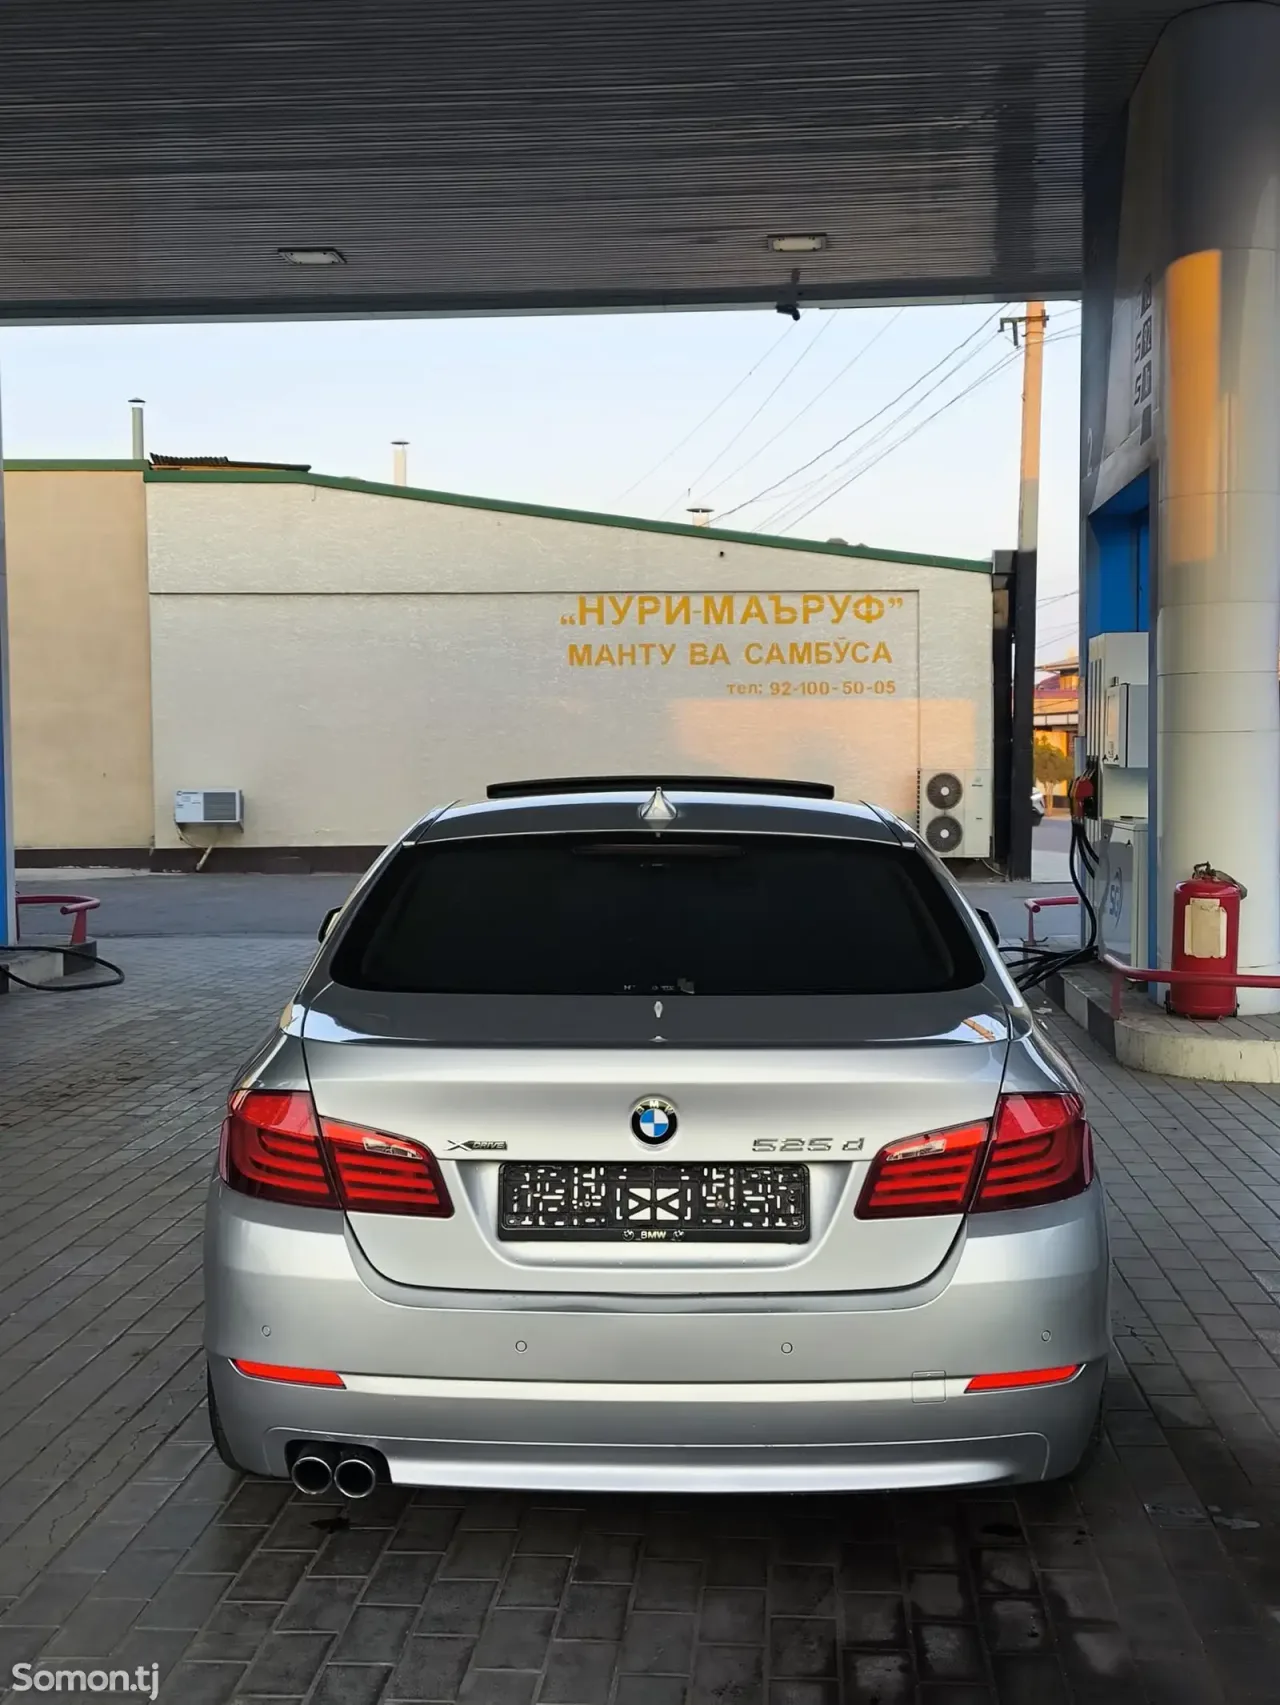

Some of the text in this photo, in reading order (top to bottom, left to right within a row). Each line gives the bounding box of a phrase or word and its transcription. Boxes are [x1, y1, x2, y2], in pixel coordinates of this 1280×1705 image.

[568, 637, 893, 666] МАНТУ ВА САМБӮСА
[635, 1100, 674, 1115] BMW
[752, 1137, 865, 1152] 525 d
[640, 1230, 667, 1239] BMW
